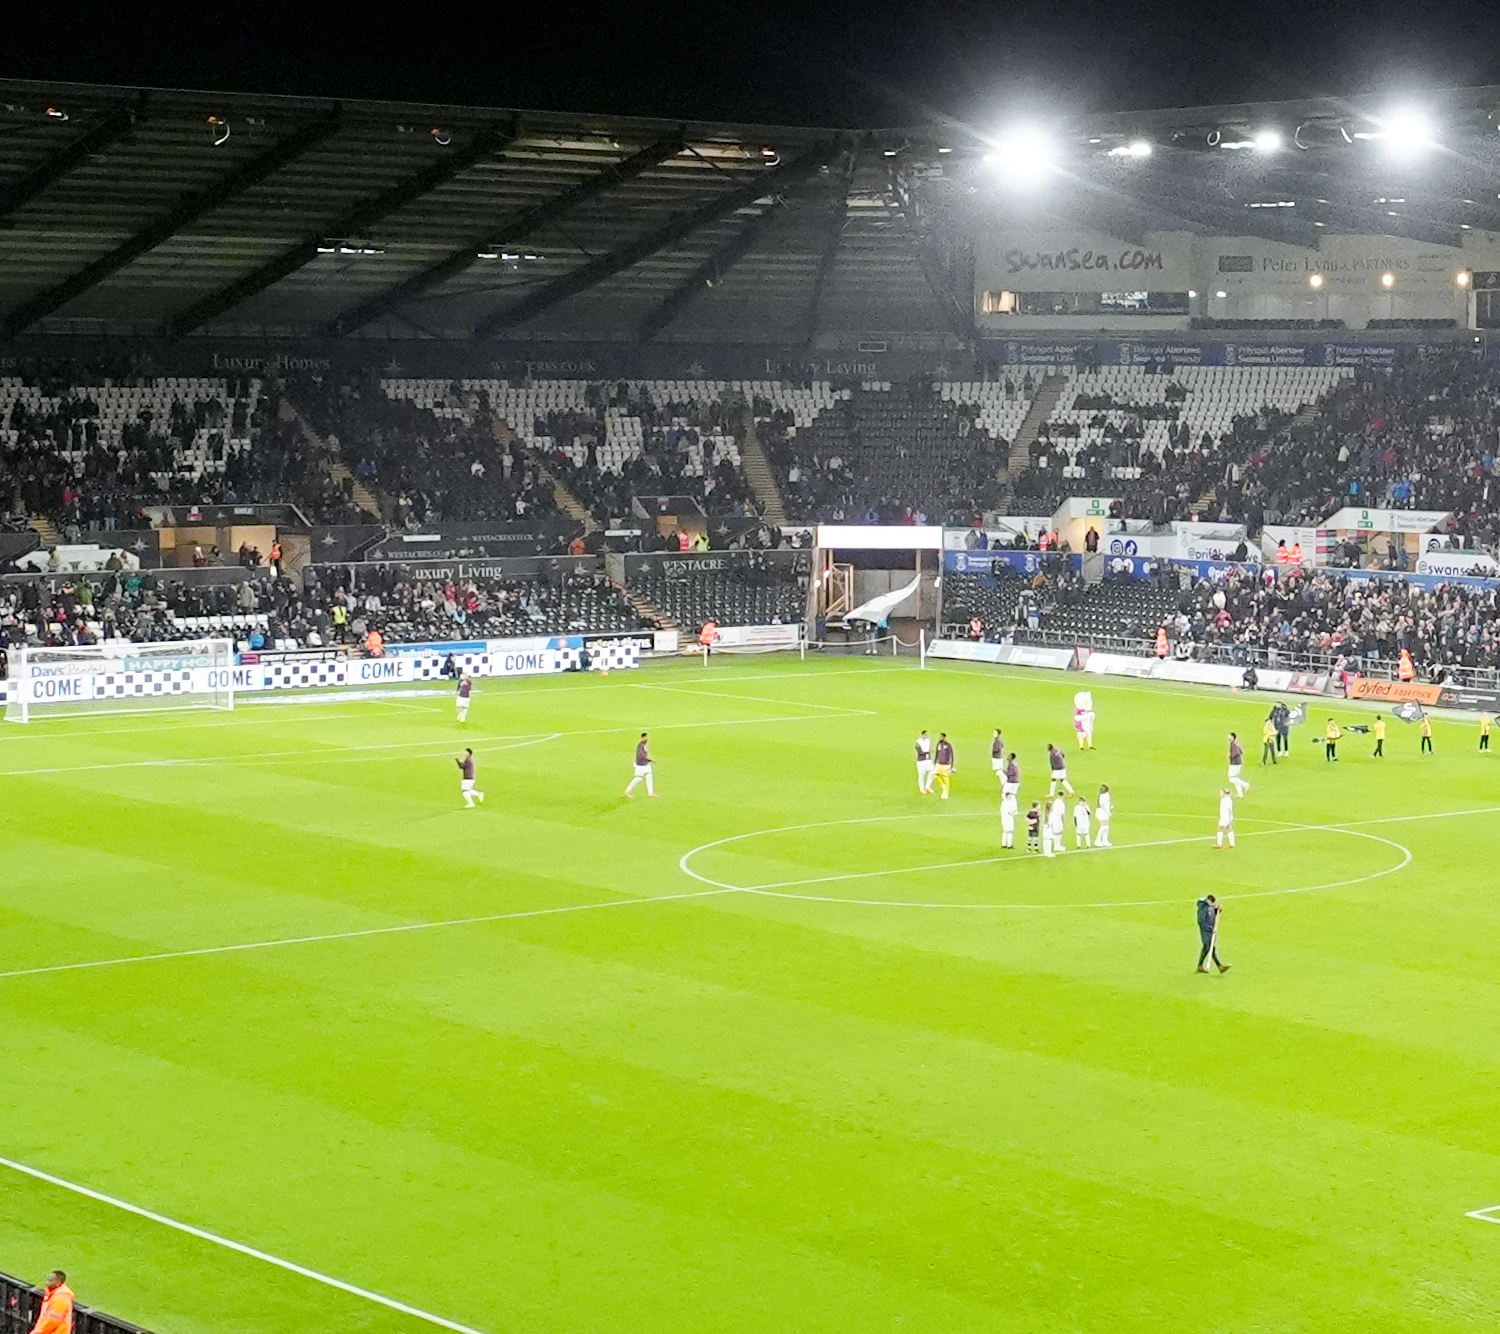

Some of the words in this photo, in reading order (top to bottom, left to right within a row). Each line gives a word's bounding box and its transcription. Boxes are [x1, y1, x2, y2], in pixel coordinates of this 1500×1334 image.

[411, 567, 455, 583] uxury
[458, 563, 503, 581] Living
[661, 560, 726, 571] WESTACRE
[361, 660, 405, 680] COME
[504, 650, 546, 671] COME
[32, 678, 82, 699] COME
[207, 669, 254, 688] COME
[1357, 680, 1393, 698] dyfed
